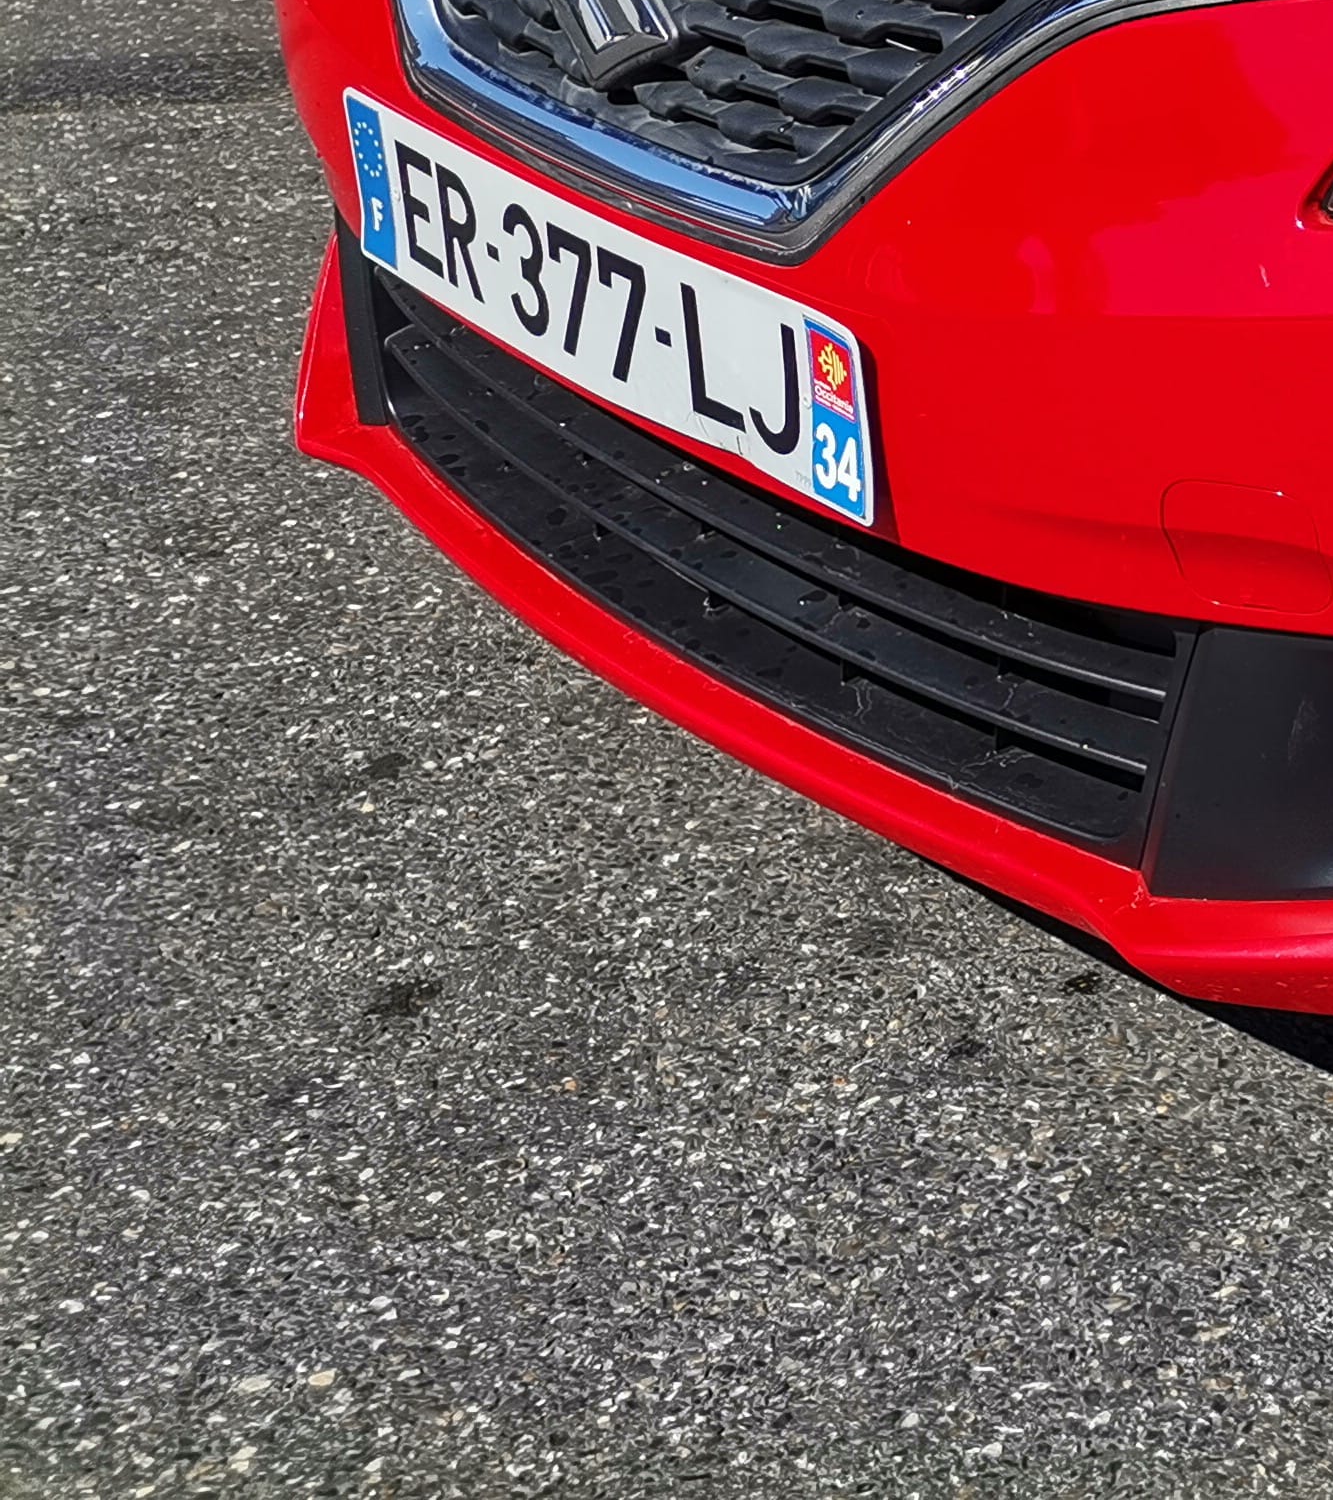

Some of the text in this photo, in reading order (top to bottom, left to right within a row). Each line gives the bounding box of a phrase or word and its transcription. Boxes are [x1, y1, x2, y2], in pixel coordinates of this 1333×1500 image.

[371, 196, 384, 232] F
[395, 140, 801, 456] ER-377-LJ
[815, 422, 862, 503] 34
